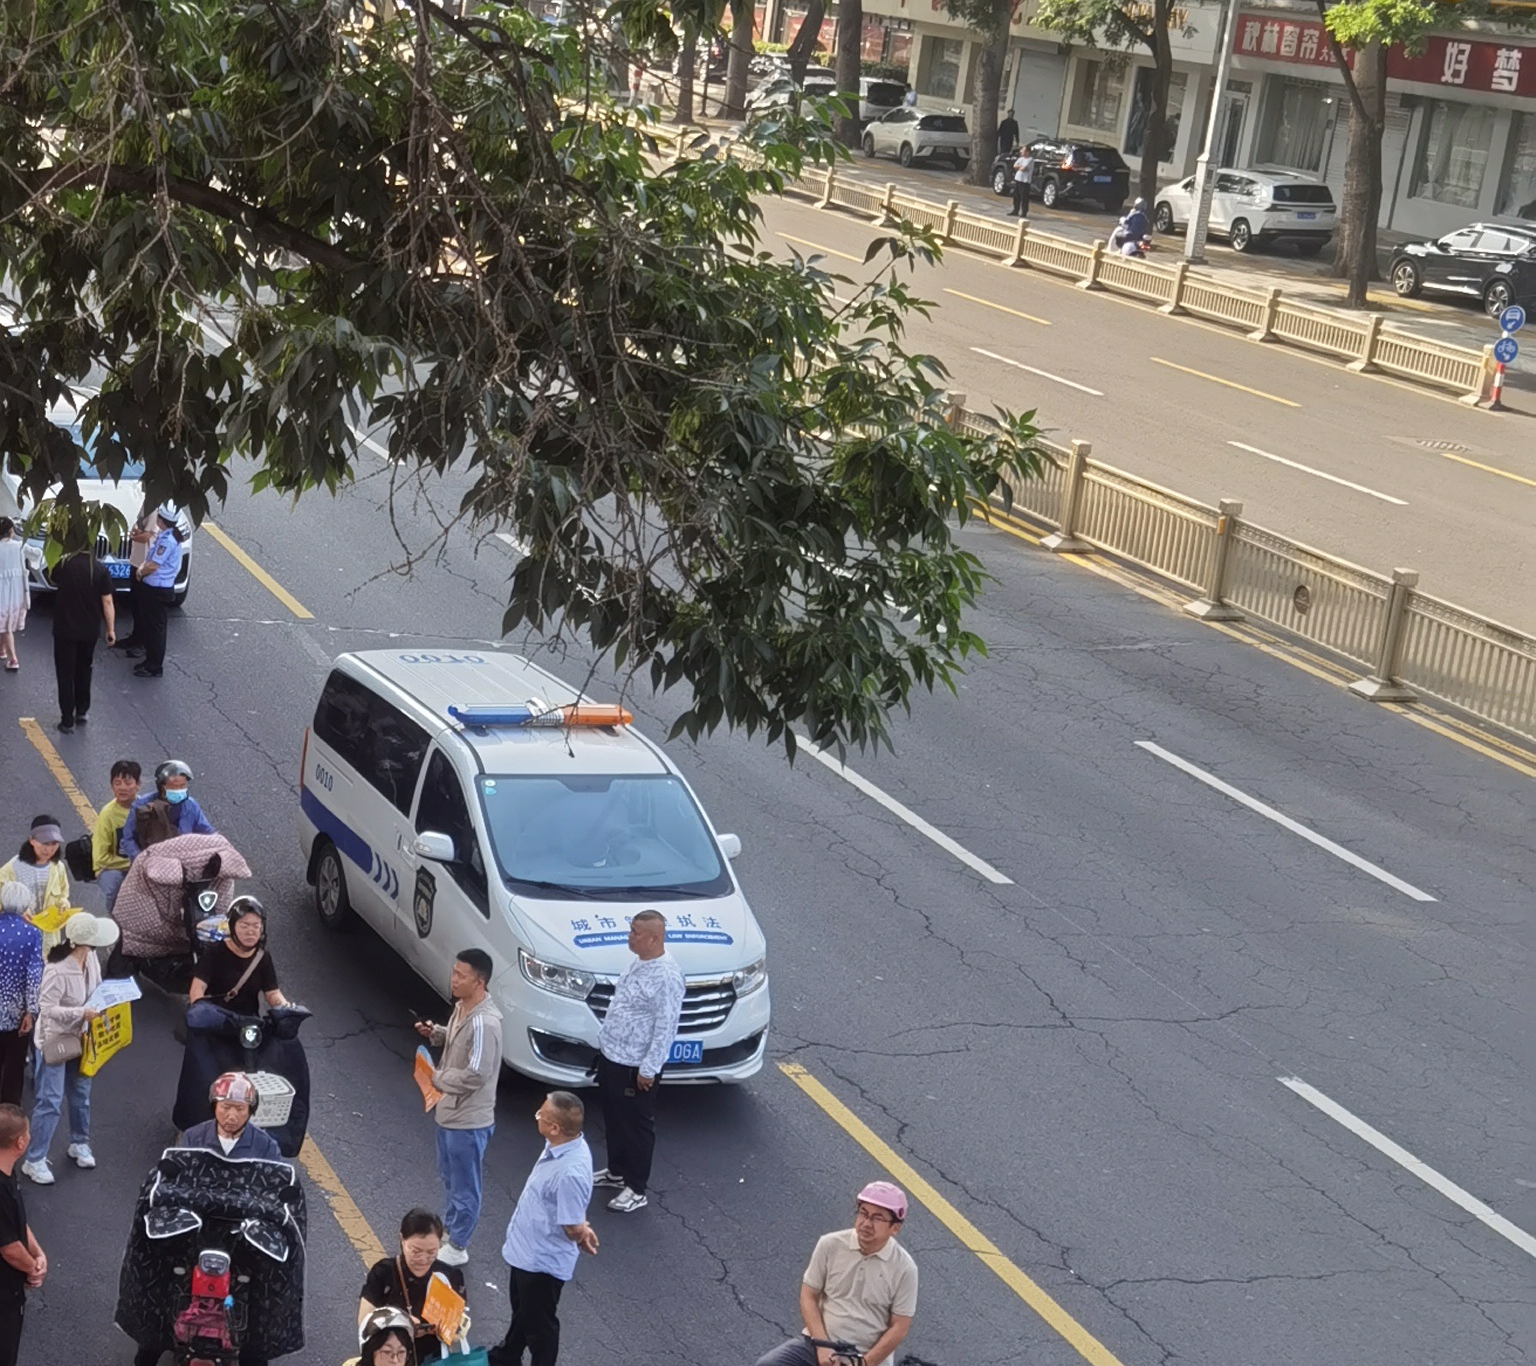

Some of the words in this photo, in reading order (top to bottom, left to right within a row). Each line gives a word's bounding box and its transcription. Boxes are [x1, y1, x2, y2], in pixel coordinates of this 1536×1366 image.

[1441, 41, 1522, 92] 好梦
[315, 763, 334, 793] 0010
[673, 1043, 701, 1060] 06A
